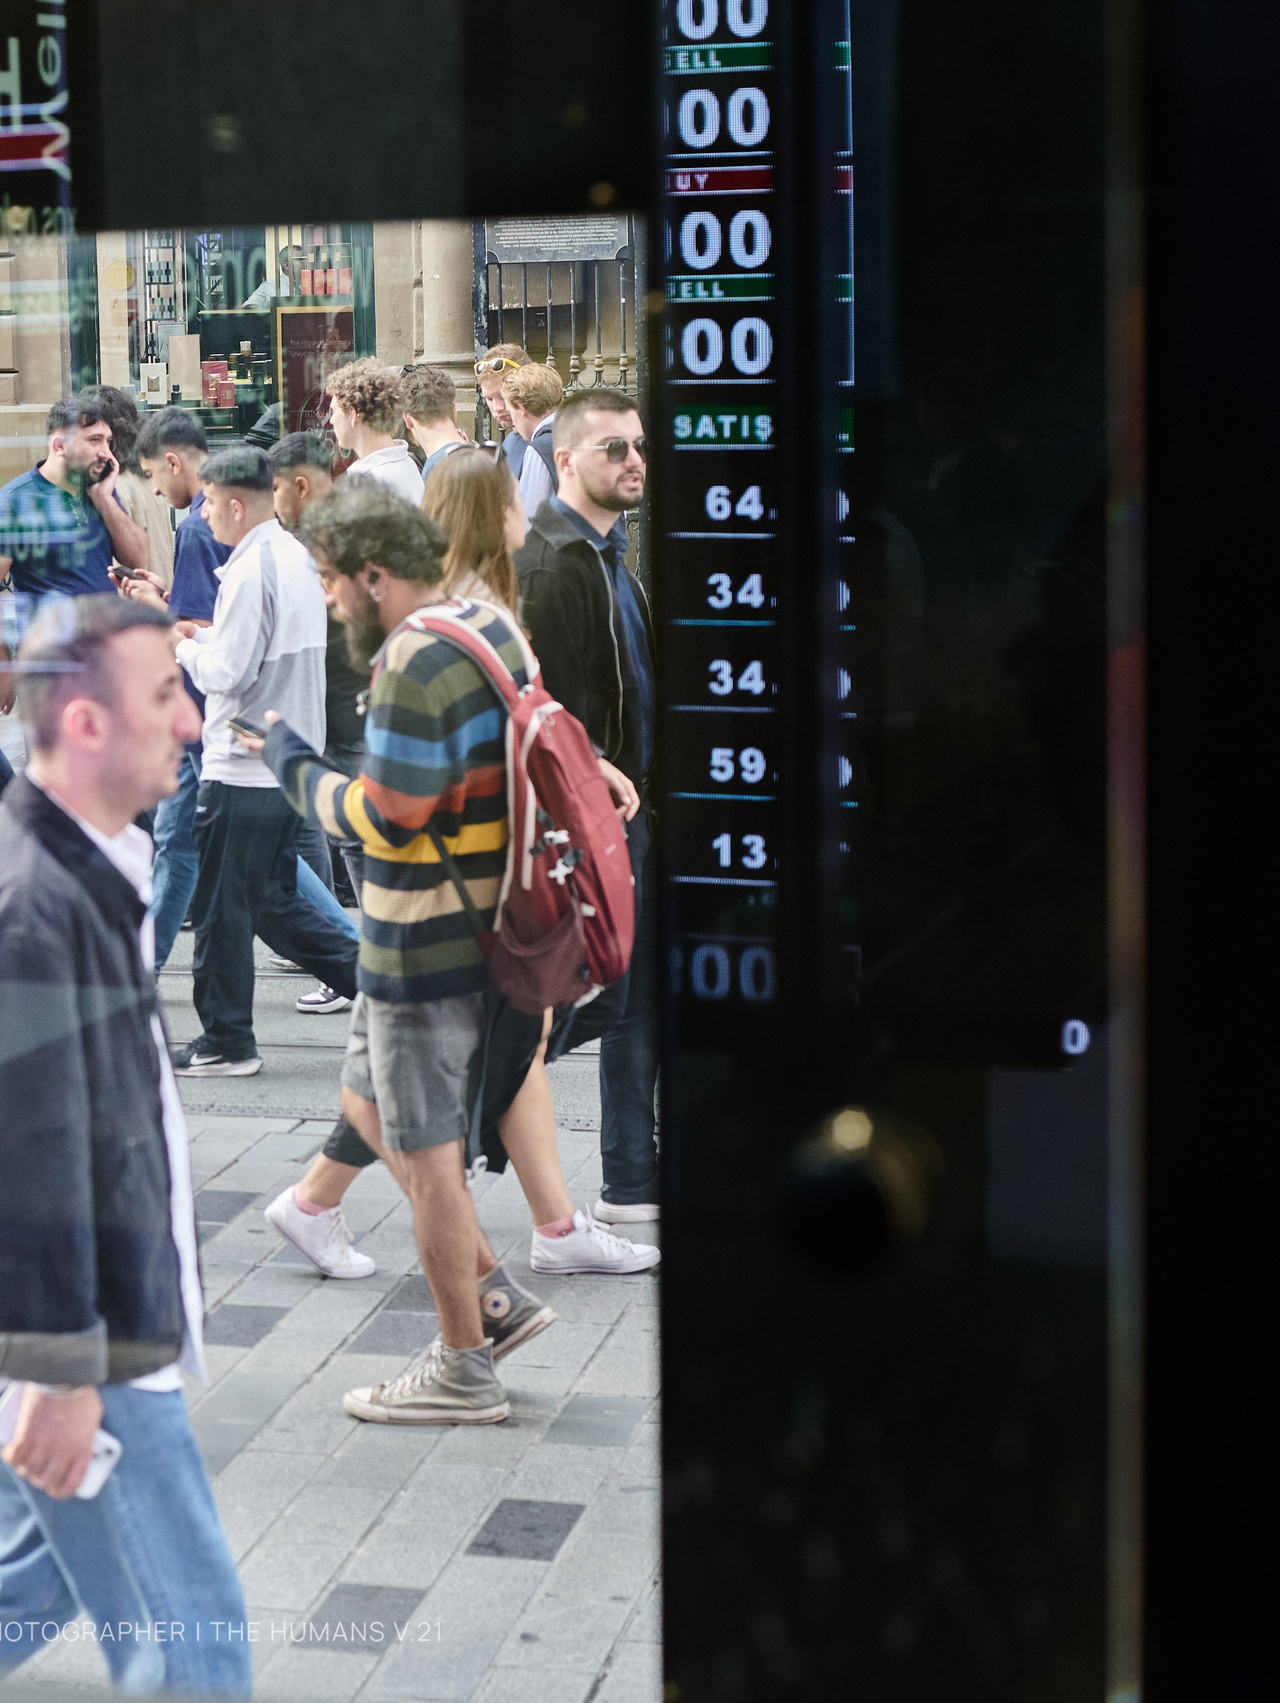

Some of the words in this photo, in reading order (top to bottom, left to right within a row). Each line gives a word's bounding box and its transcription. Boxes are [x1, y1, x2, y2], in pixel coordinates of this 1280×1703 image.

[662, 0, 769, 40] 00
[666, 51, 722, 69] ELL
[663, 86, 770, 149] 00
[666, 172, 709, 190] UY
[664, 209, 772, 270] 00
[667, 280, 725, 298] ELL
[665, 316, 773, 375] 00
[673, 413, 773, 444] SATIŞ
[670, 943, 777, 1001] 00
